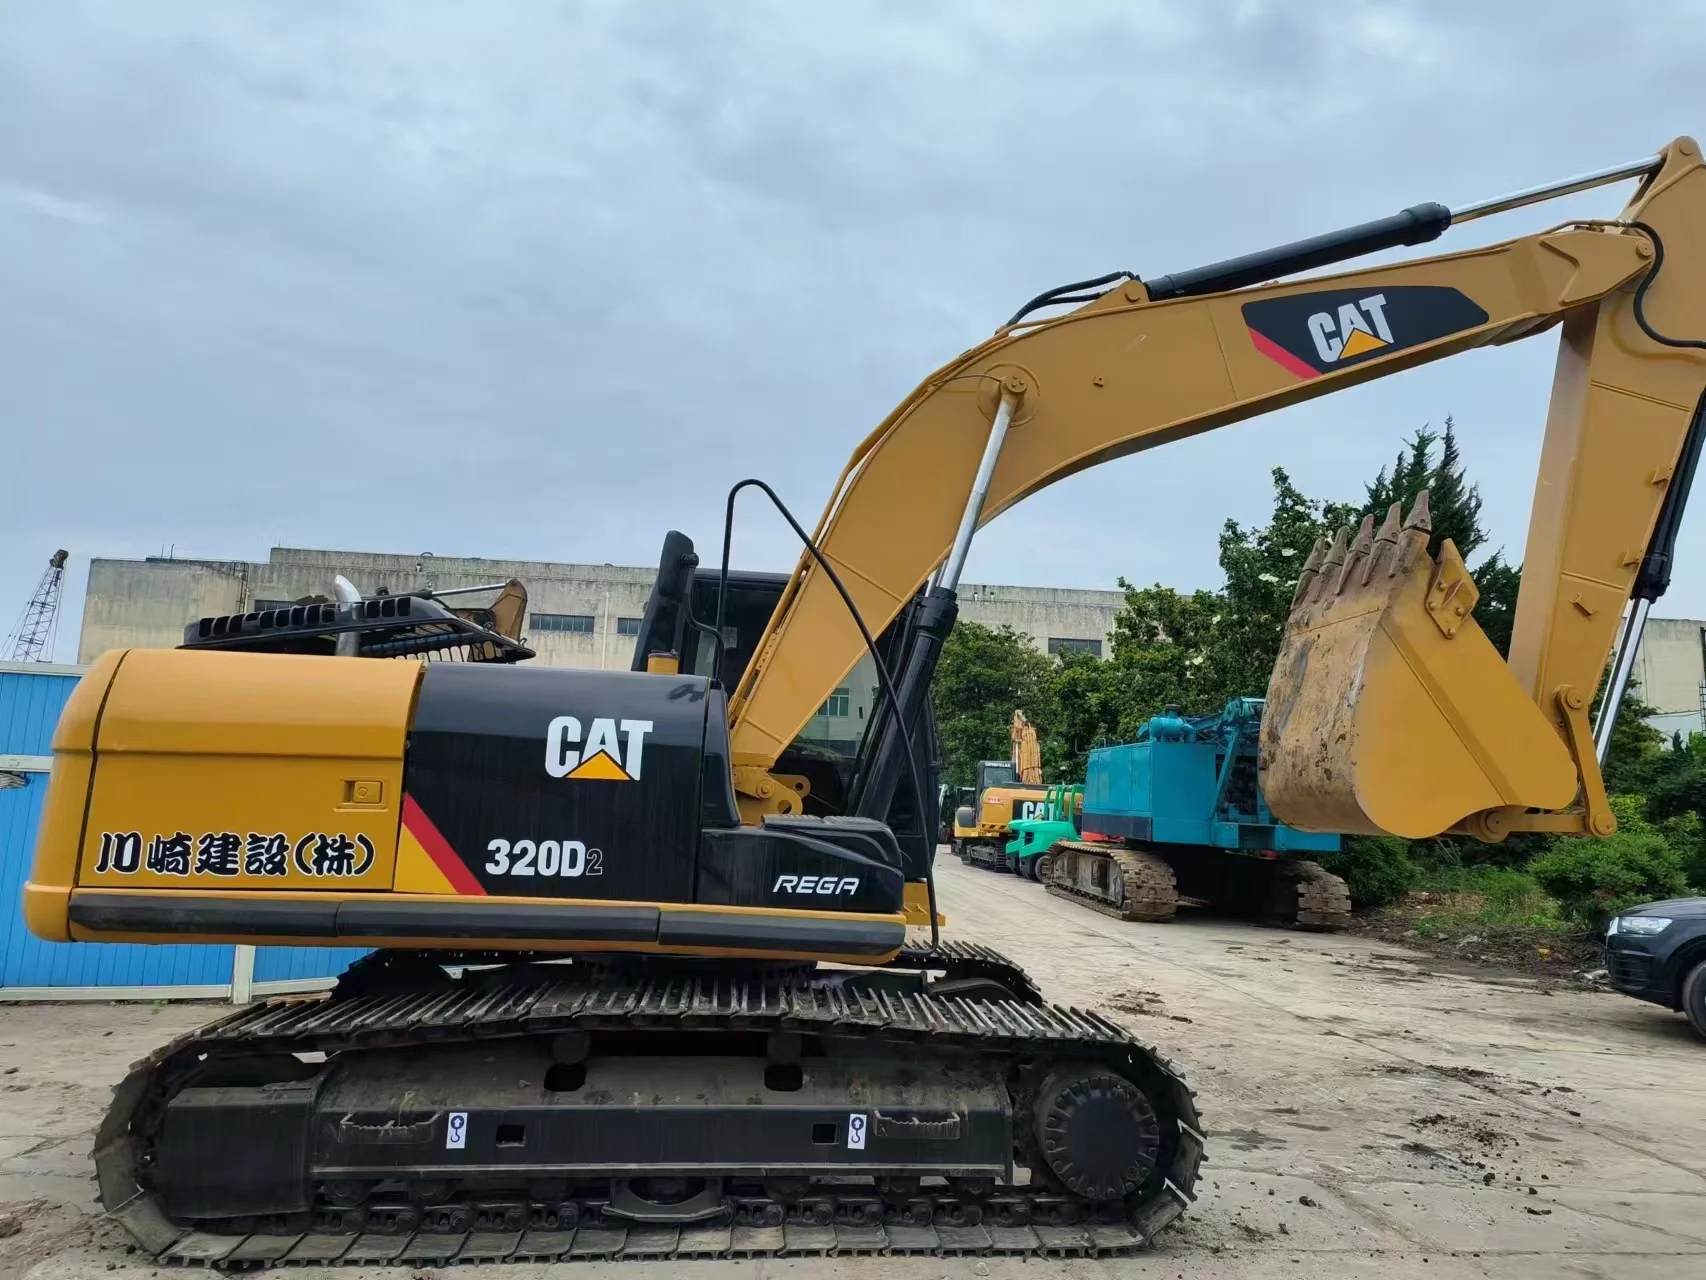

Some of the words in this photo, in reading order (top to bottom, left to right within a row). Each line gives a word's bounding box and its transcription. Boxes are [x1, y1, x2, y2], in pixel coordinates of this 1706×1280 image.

[1307, 293, 1394, 363] CAT
[544, 715, 654, 781] CAT
[485, 838, 603, 877] 320D2
[772, 875, 860, 895] REGA
